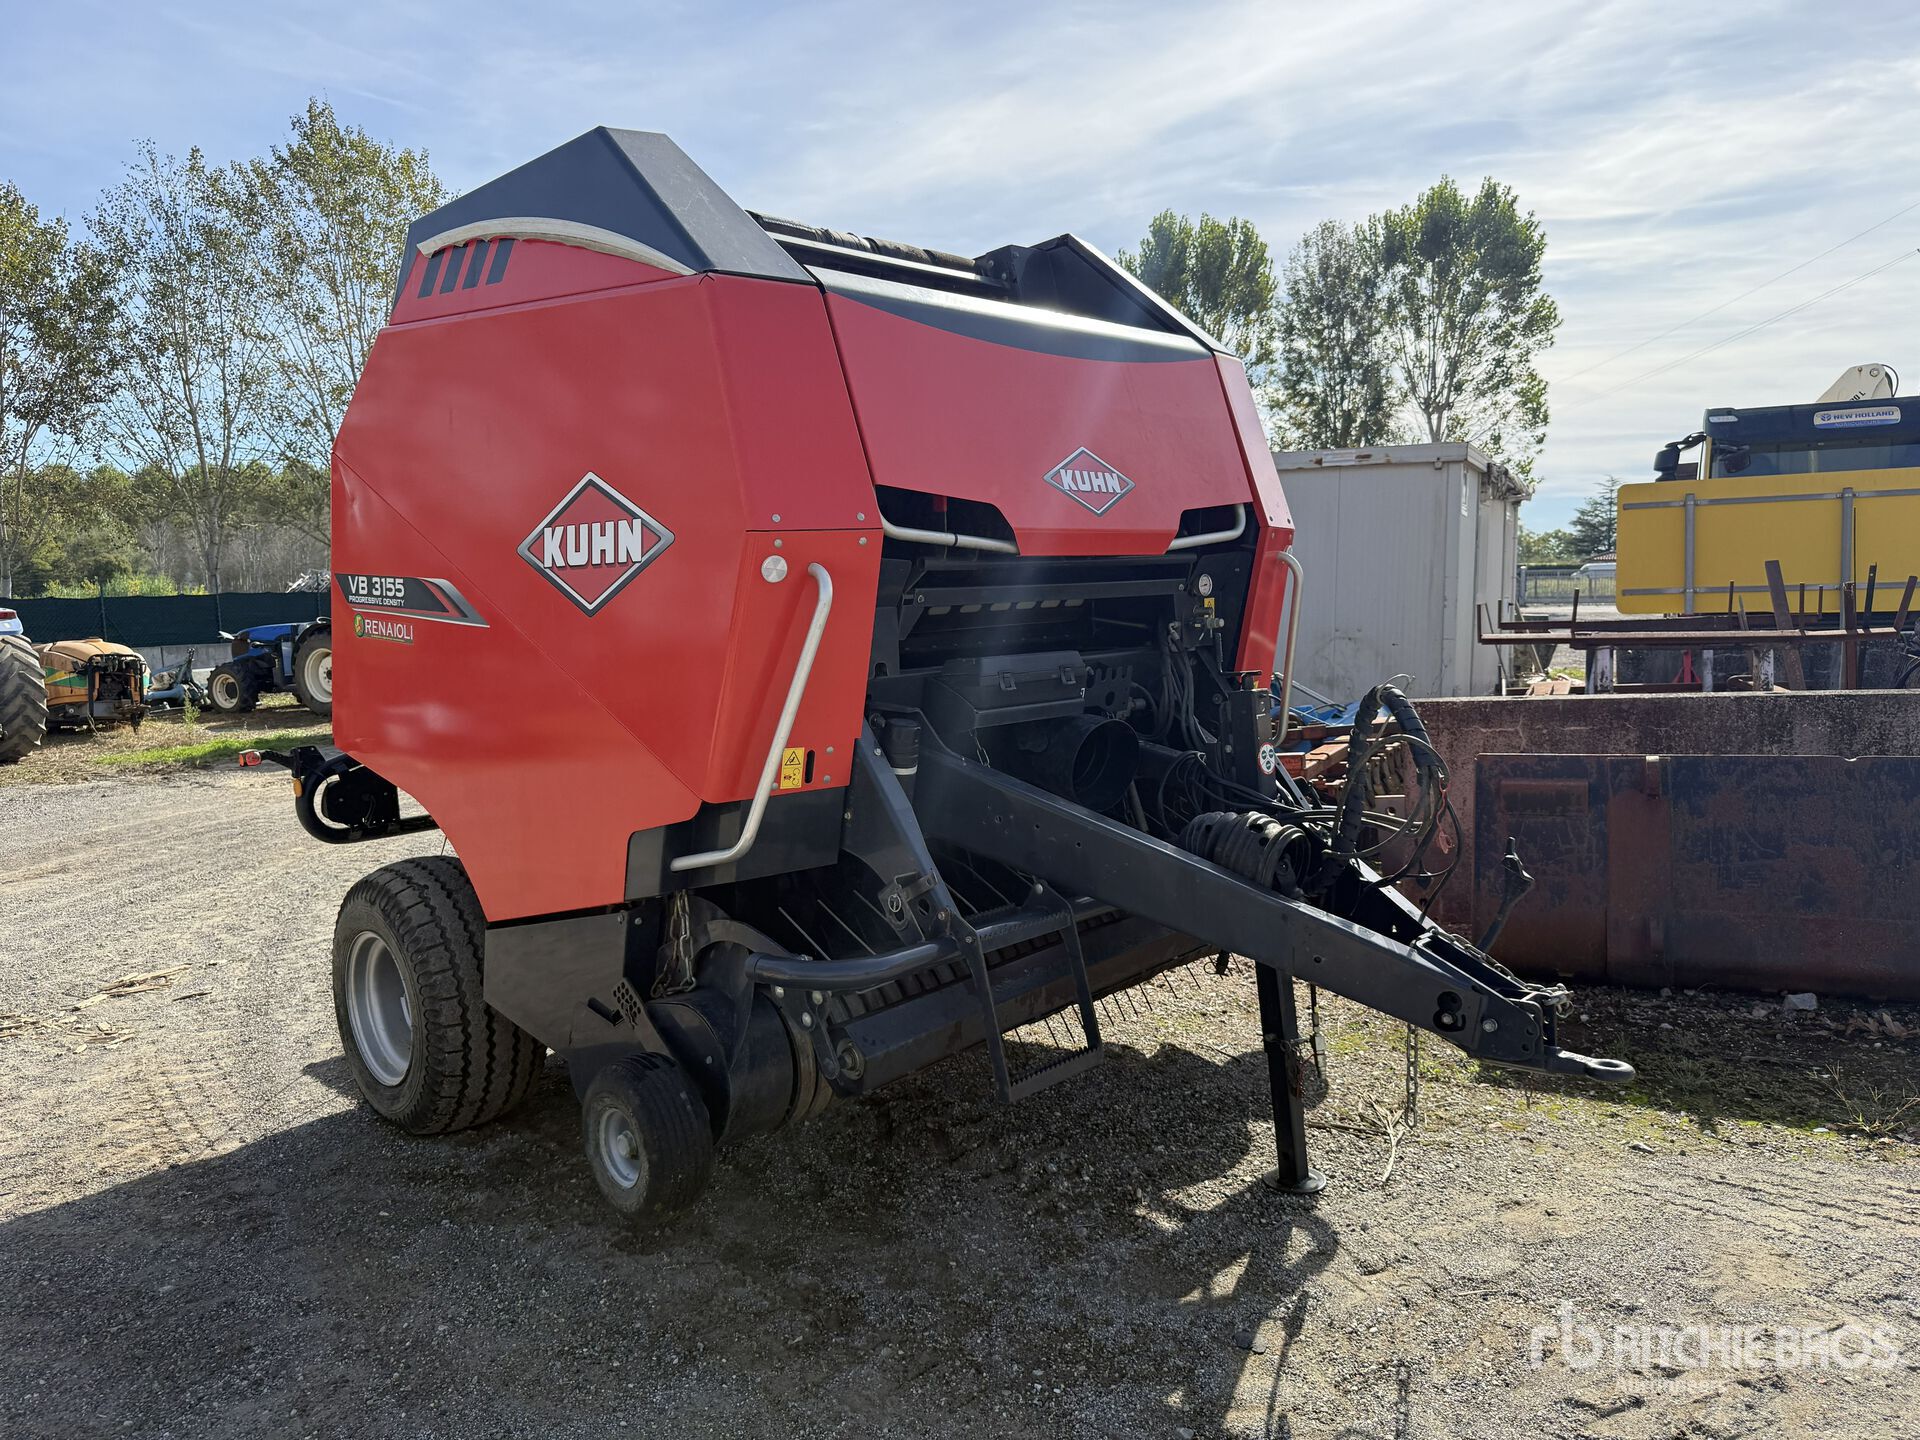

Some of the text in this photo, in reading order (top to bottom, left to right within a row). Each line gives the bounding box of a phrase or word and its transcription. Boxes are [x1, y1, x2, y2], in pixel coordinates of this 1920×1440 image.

[1854, 411, 1894, 419] HOLLAND
[1060, 468, 1121, 494] KUHN
[543, 518, 642, 568] KUHN
[348, 576, 405, 597] VB 3155
[348, 595, 405, 606] PROGRESSIVE DENSITY
[365, 619, 413, 640] RENAIOLI
